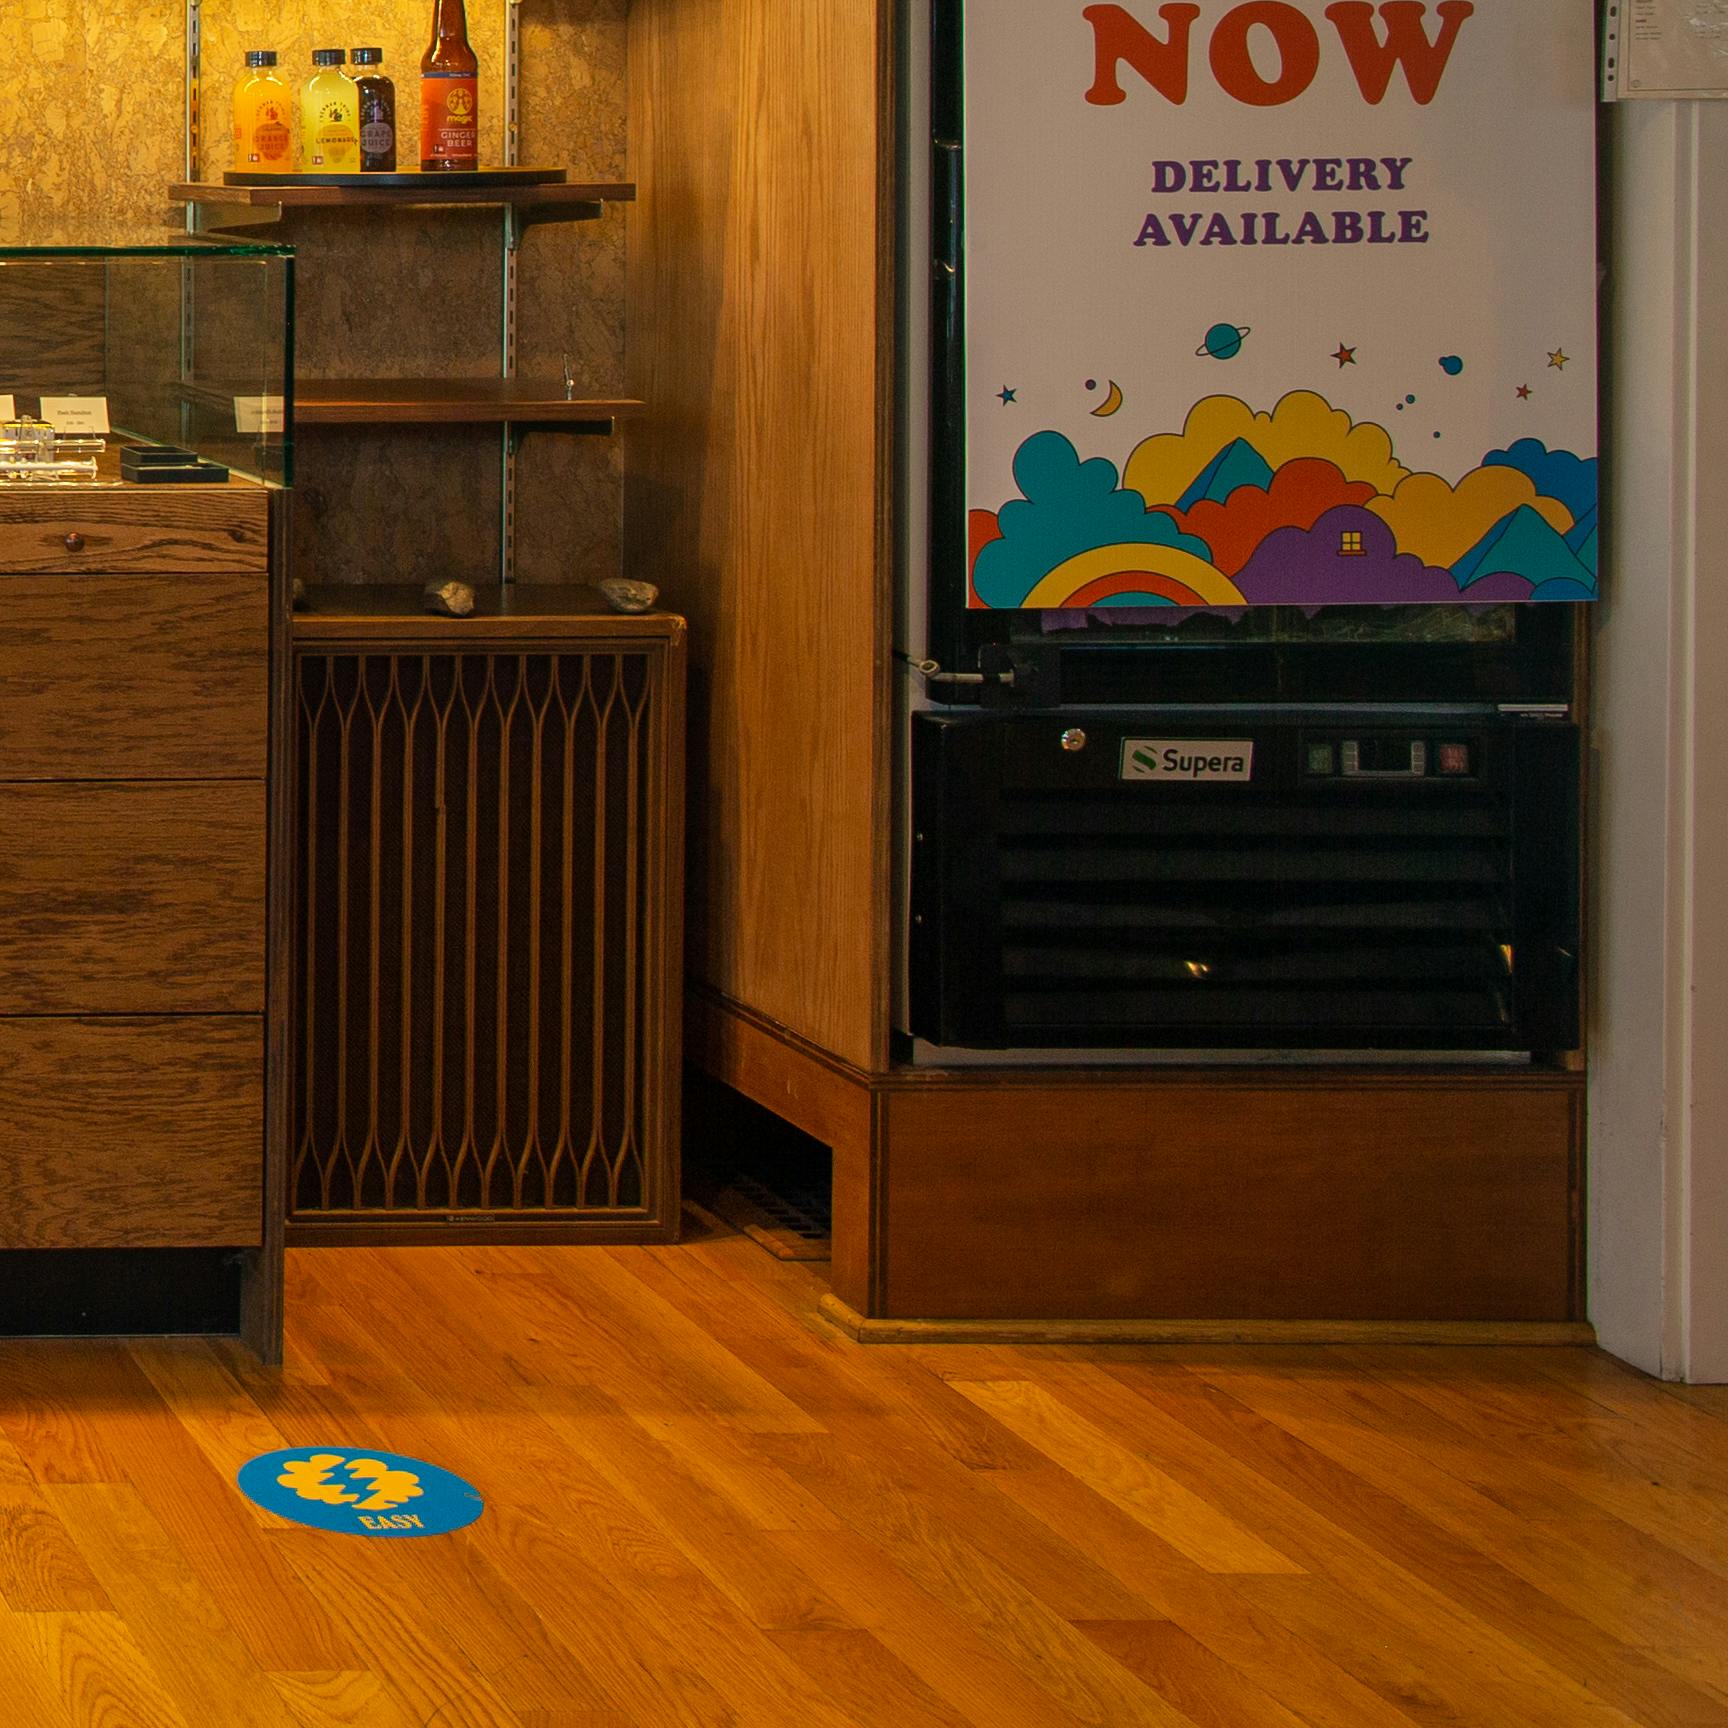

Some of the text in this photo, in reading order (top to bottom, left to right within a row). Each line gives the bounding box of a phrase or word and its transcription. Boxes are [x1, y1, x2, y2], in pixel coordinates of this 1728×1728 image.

[1082, 0, 1475, 107] NOW
[1151, 157, 1413, 194] DELIVERY
[1132, 210, 1430, 247] AVAILABLE
[1162, 748, 1245, 779] Supera
[358, 1514, 425, 1530] EASY
